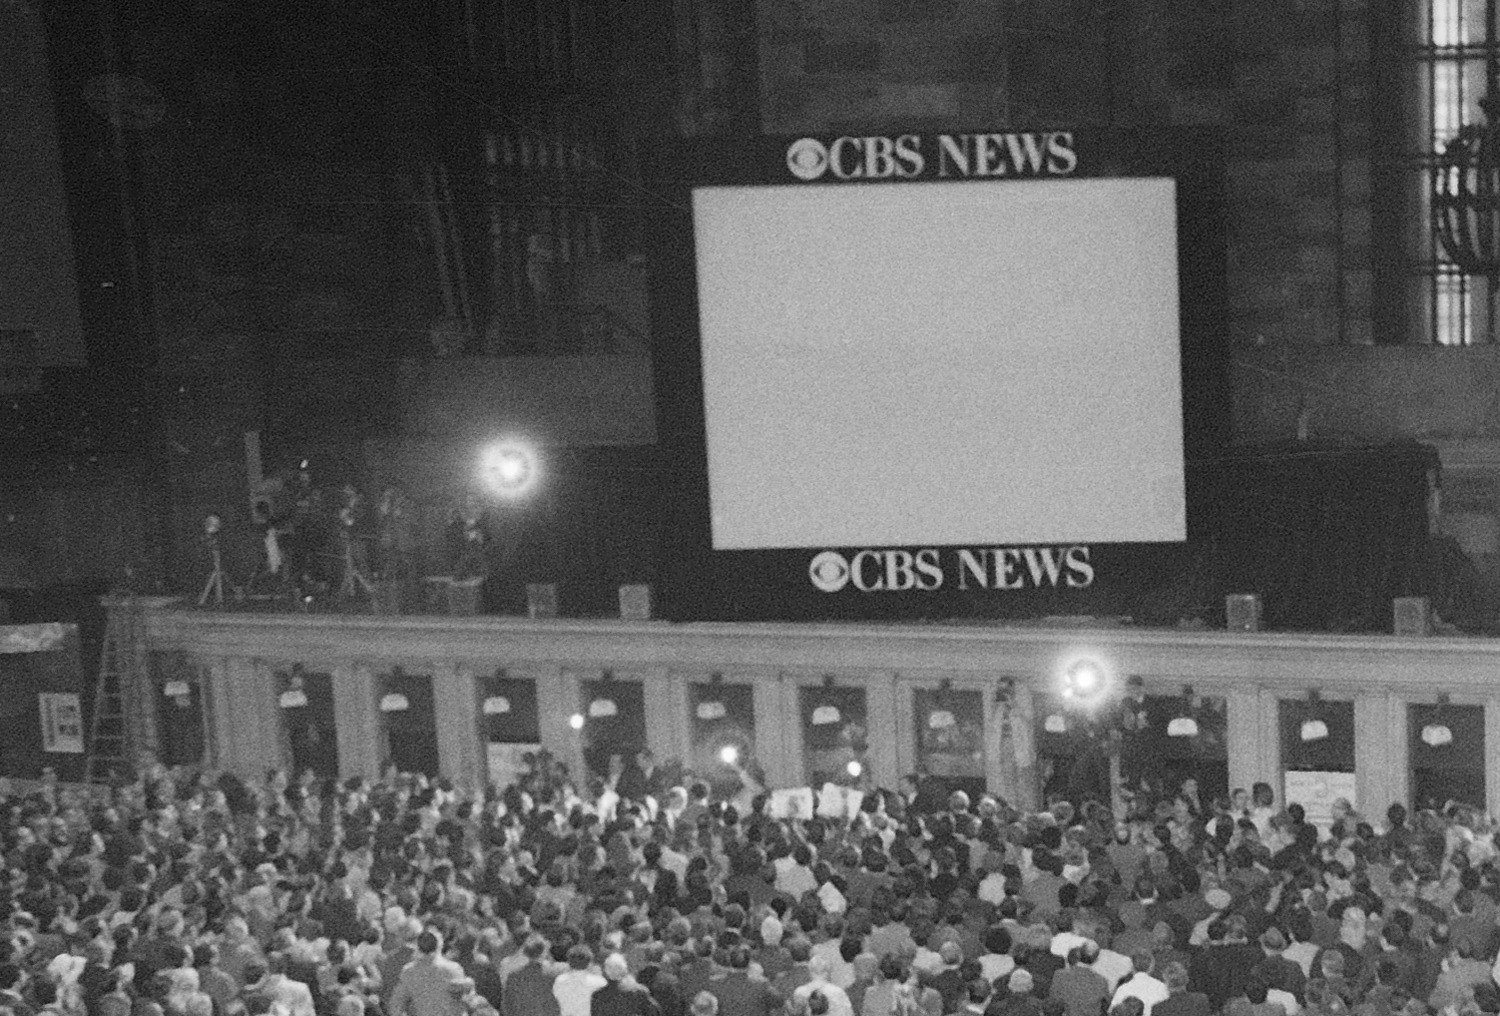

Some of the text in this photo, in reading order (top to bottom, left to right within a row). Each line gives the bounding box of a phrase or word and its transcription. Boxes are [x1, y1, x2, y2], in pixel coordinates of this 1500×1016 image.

[829, 132, 1077, 180] CBS NEWS
[850, 546, 1094, 593] CBS NEWS
